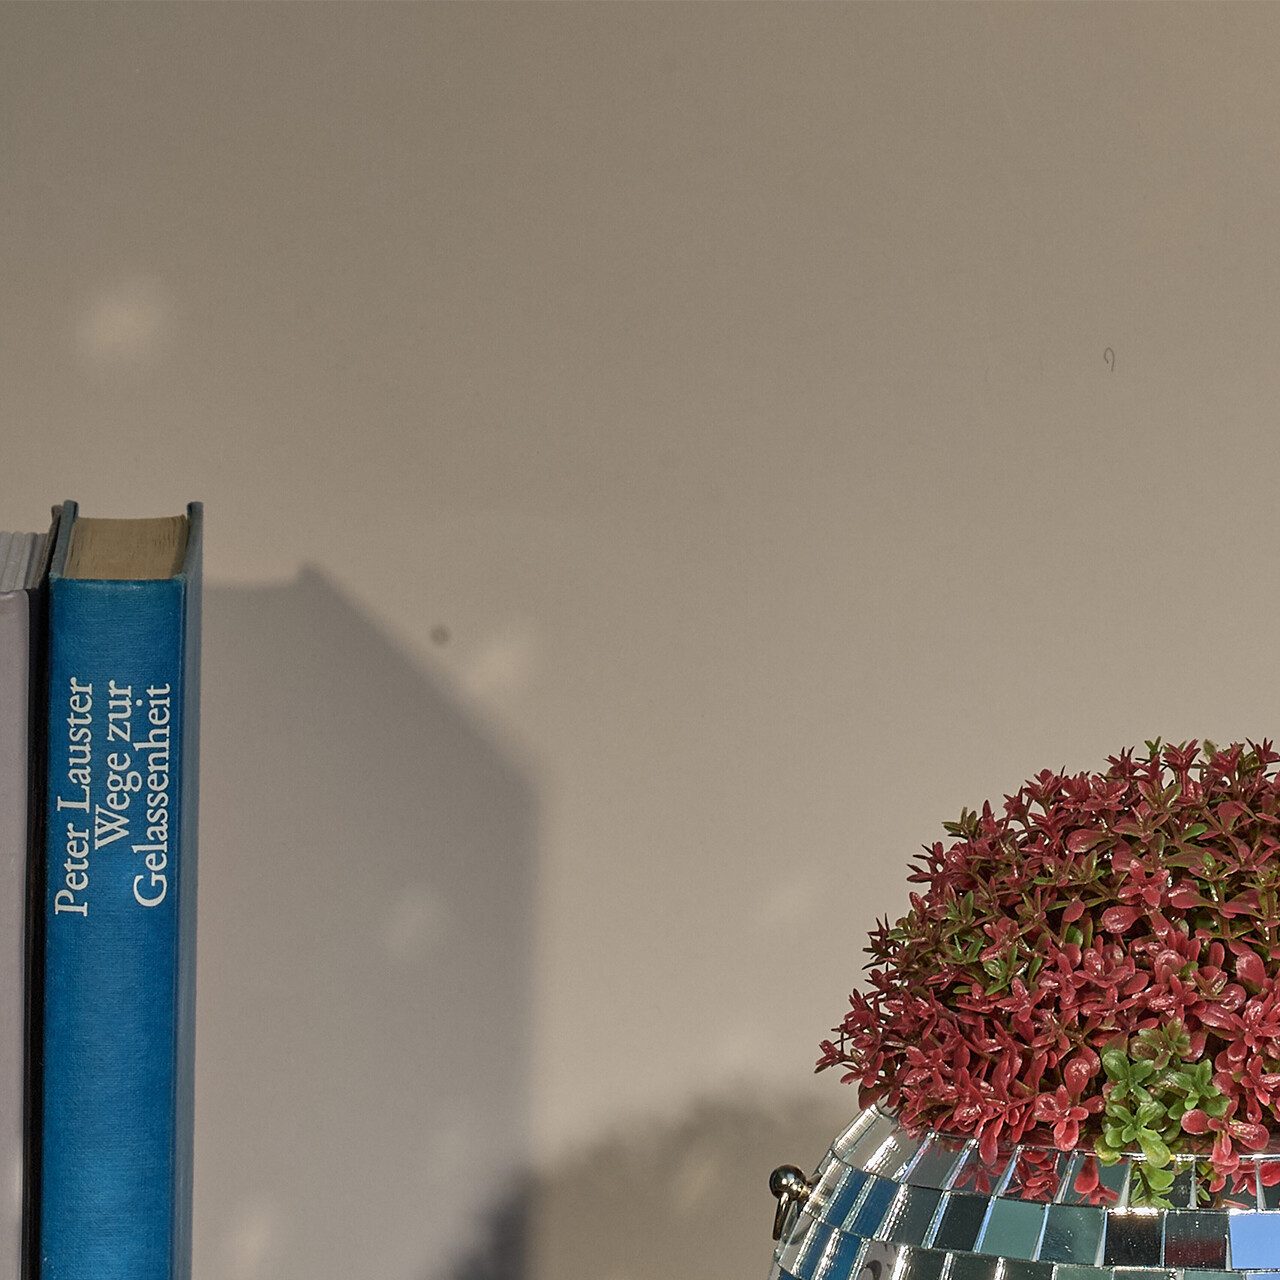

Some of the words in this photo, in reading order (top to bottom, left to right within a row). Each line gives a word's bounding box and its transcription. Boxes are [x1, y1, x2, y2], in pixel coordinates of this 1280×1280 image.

[56, 676, 93, 814] Lauster
[106, 678, 132, 743] zur
[95, 752, 143, 850] Wege
[132, 682, 171, 908] Gelassenheit
[55, 821, 91, 917] Peter
